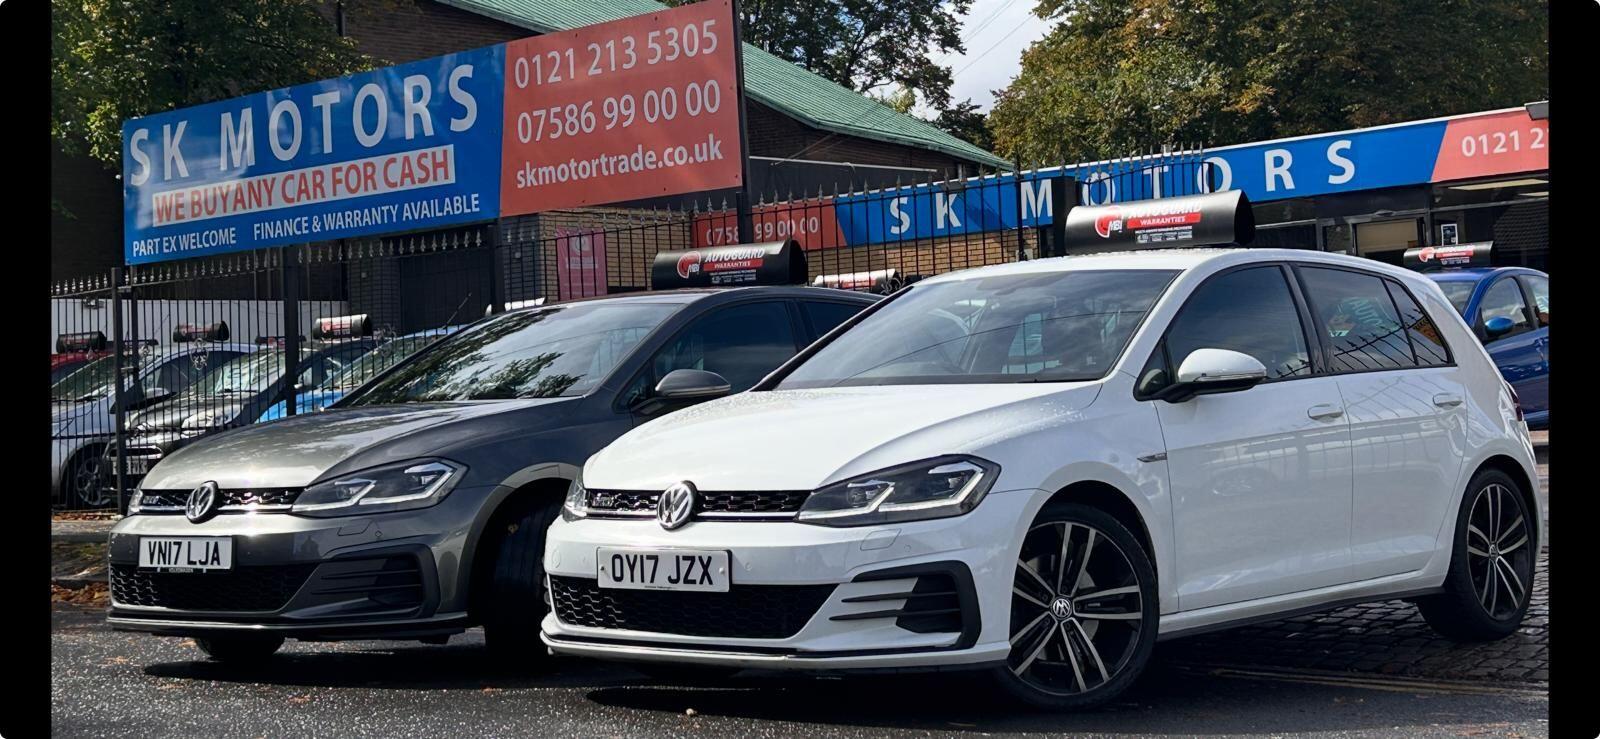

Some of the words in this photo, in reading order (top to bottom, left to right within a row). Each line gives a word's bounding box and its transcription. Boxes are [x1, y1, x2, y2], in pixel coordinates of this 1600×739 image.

[514, 48, 576, 89] 0121
[587, 35, 637, 77] 213
[647, 19, 718, 65] 5305
[220, 64, 478, 171] MOTORS
[517, 100, 596, 144] 07586
[602, 94, 636, 131] 99
[643, 86, 677, 123] 00
[685, 79, 721, 117] 00
[1461, 129, 1520, 157] 0121
[1530, 127, 1548, 149] 2
[516, 133, 723, 189] skmotortrade.co.uk
[154, 191, 185, 223] WE
[281, 169, 326, 205] CAR
[332, 161, 377, 197] FOR
[383, 149, 449, 189] CASH
[253, 216, 309, 241] FINANCE
[312, 215, 322, 232] &
[323, 203, 399, 231] WARRANTY
[402, 193, 480, 222] AVAILABLE
[755, 222, 773, 239] 99
[777, 218, 796, 238] 00
[1140, 215, 1186, 226] WARRANTIES
[133, 238, 160, 257] PART
[162, 235, 177, 254] EX
[178, 227, 237, 251] WELCOME
[705, 249, 765, 262] AUTOGUARD
[148, 541, 183, 566] VN17
[187, 541, 221, 566] LJA
[611, 553, 659, 584] OY17
[667, 555, 714, 585] JZX
